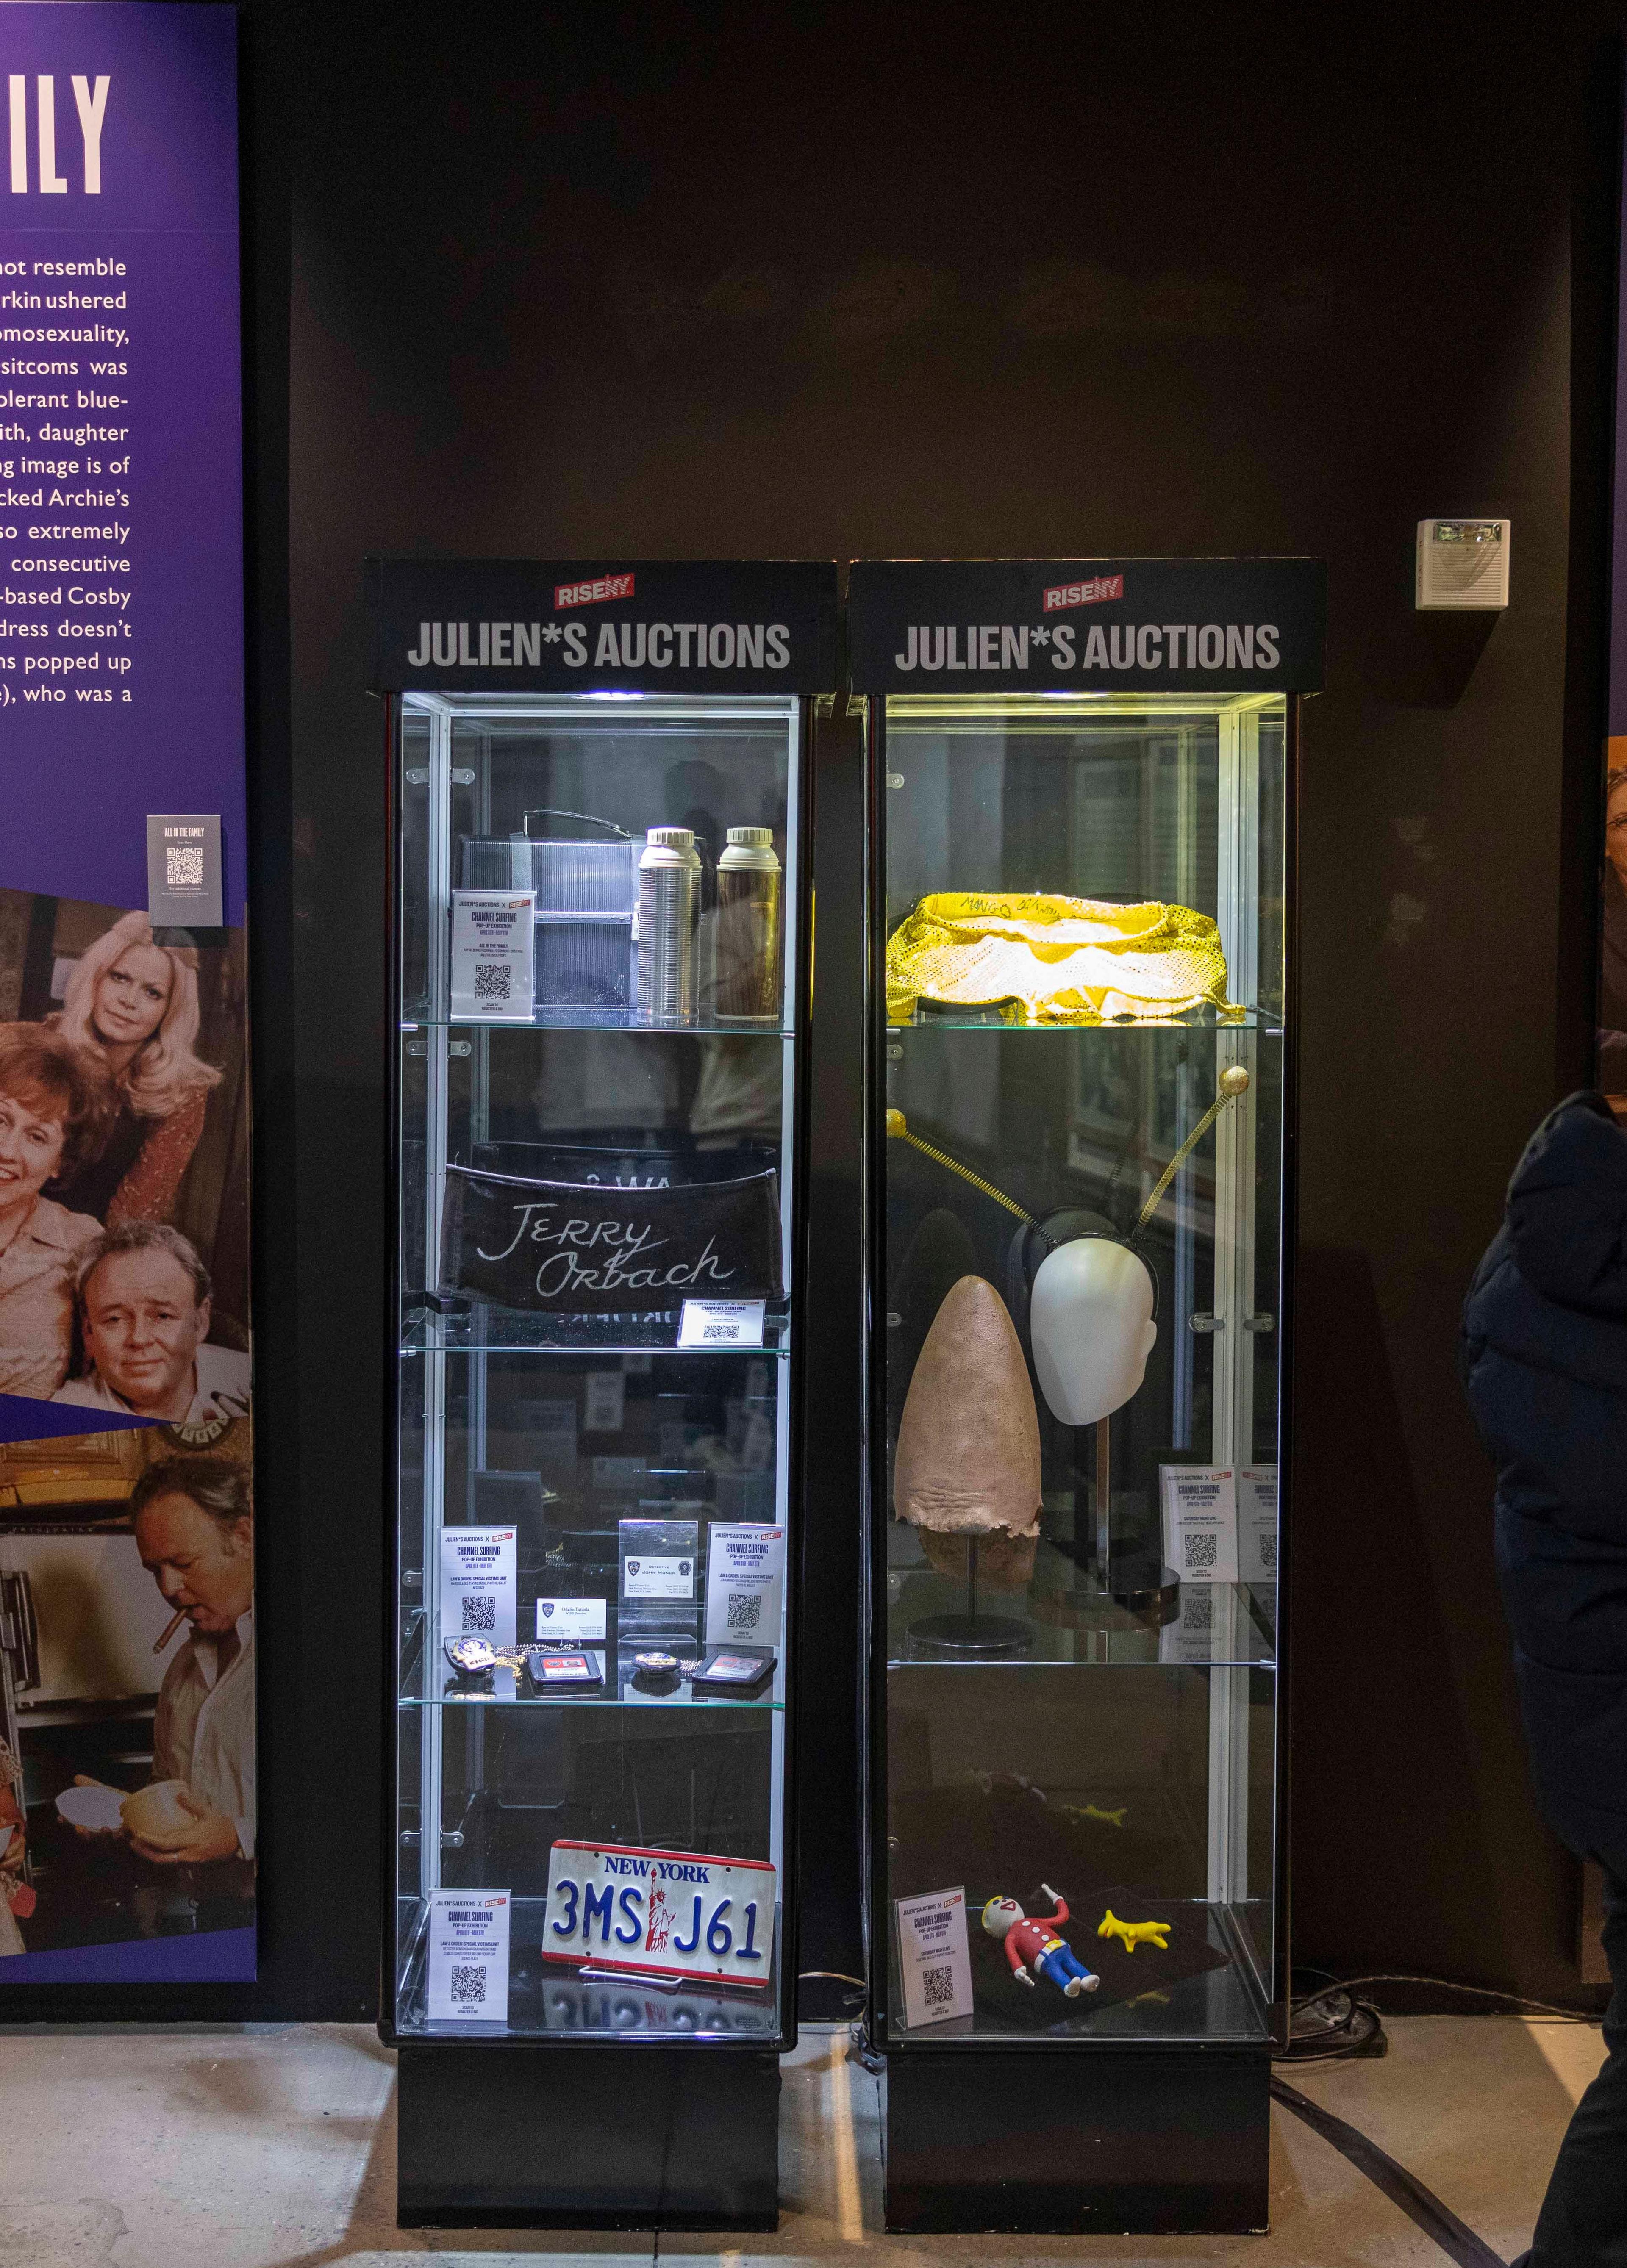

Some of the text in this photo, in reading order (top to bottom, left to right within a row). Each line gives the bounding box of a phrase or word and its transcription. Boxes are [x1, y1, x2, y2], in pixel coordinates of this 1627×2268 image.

[9, 75, 111, 194] ILY
[34, 258, 126, 276] resemble
[46, 291, 126, 309] ushered
[0, 324, 129, 347] mosexuality,
[1, 358, 128, 375] sitcoms was
[78, 390, 128, 408] blue-
[39, 423, 129, 446] daughter
[22, 456, 130, 479] image is of
[28, 521, 130, 544] extremely
[11, 555, 130, 572] consecutive
[68, 586, 131, 610] Cosby
[594, 623, 790, 668] AUCTIONS
[1083, 624, 1280, 669] AUCTIONS
[25, 652, 99, 674] popped
[108, 657, 131, 675] up
[23, 684, 132, 702] who was a
[179, 828, 188, 837] THE
[189, 828, 204, 837] FAMILY
[472, 912, 517, 922] CHANNEL SURFING
[1179, 1485, 1220, 1494] CHANNEL SURFING
[458, 1546, 500, 1555] CHANNEL SURFING
[726, 1543, 768, 1553] CHANNEL SURFING
[604, 1855, 710, 1884] NEW YORK
[448, 1911, 493, 1921] CHANNEL SURFING
[919, 1904, 936, 1912] AUCTIONS
[553, 1879, 761, 1959] 3MS J61
[914, 1911, 952, 1928] CHANNEL SURFING
